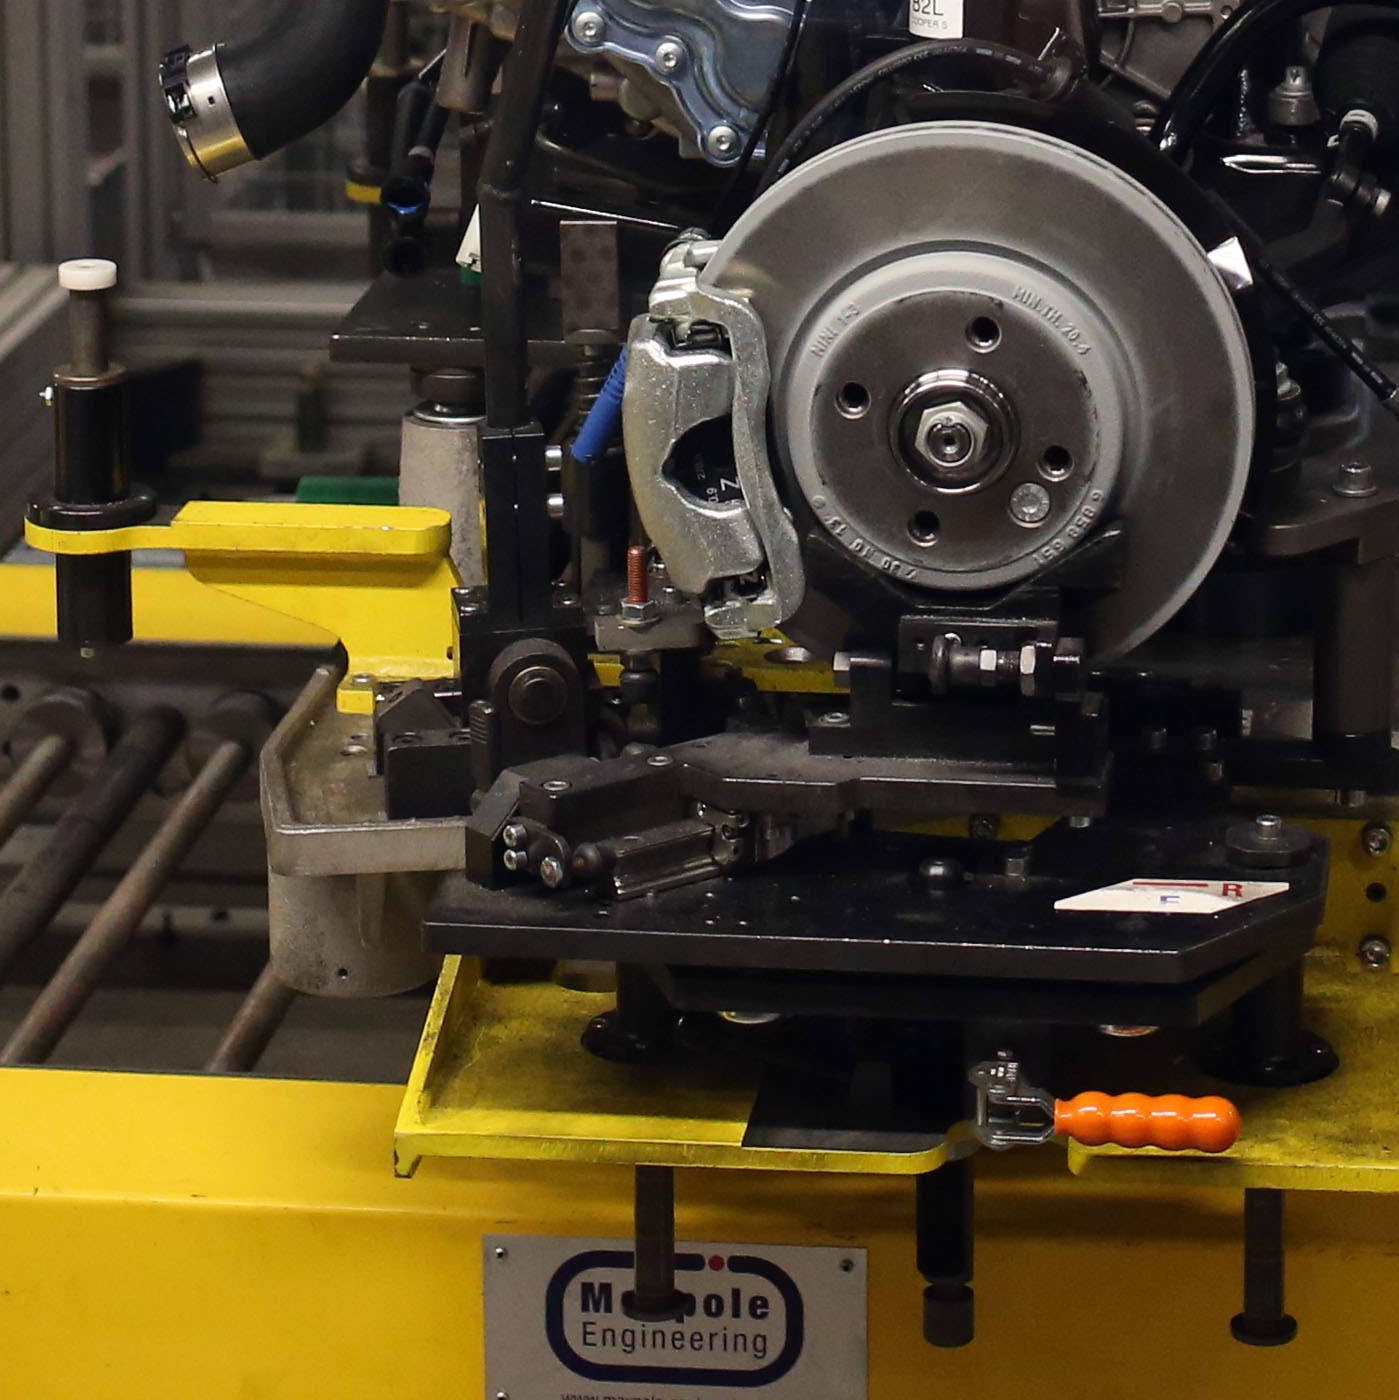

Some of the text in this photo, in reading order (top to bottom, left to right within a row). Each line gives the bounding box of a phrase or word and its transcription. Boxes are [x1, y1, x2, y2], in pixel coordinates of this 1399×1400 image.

[1222, 882, 1244, 898] R
[579, 1281, 771, 1324] Mpole
[581, 1321, 769, 1359] Engineering
